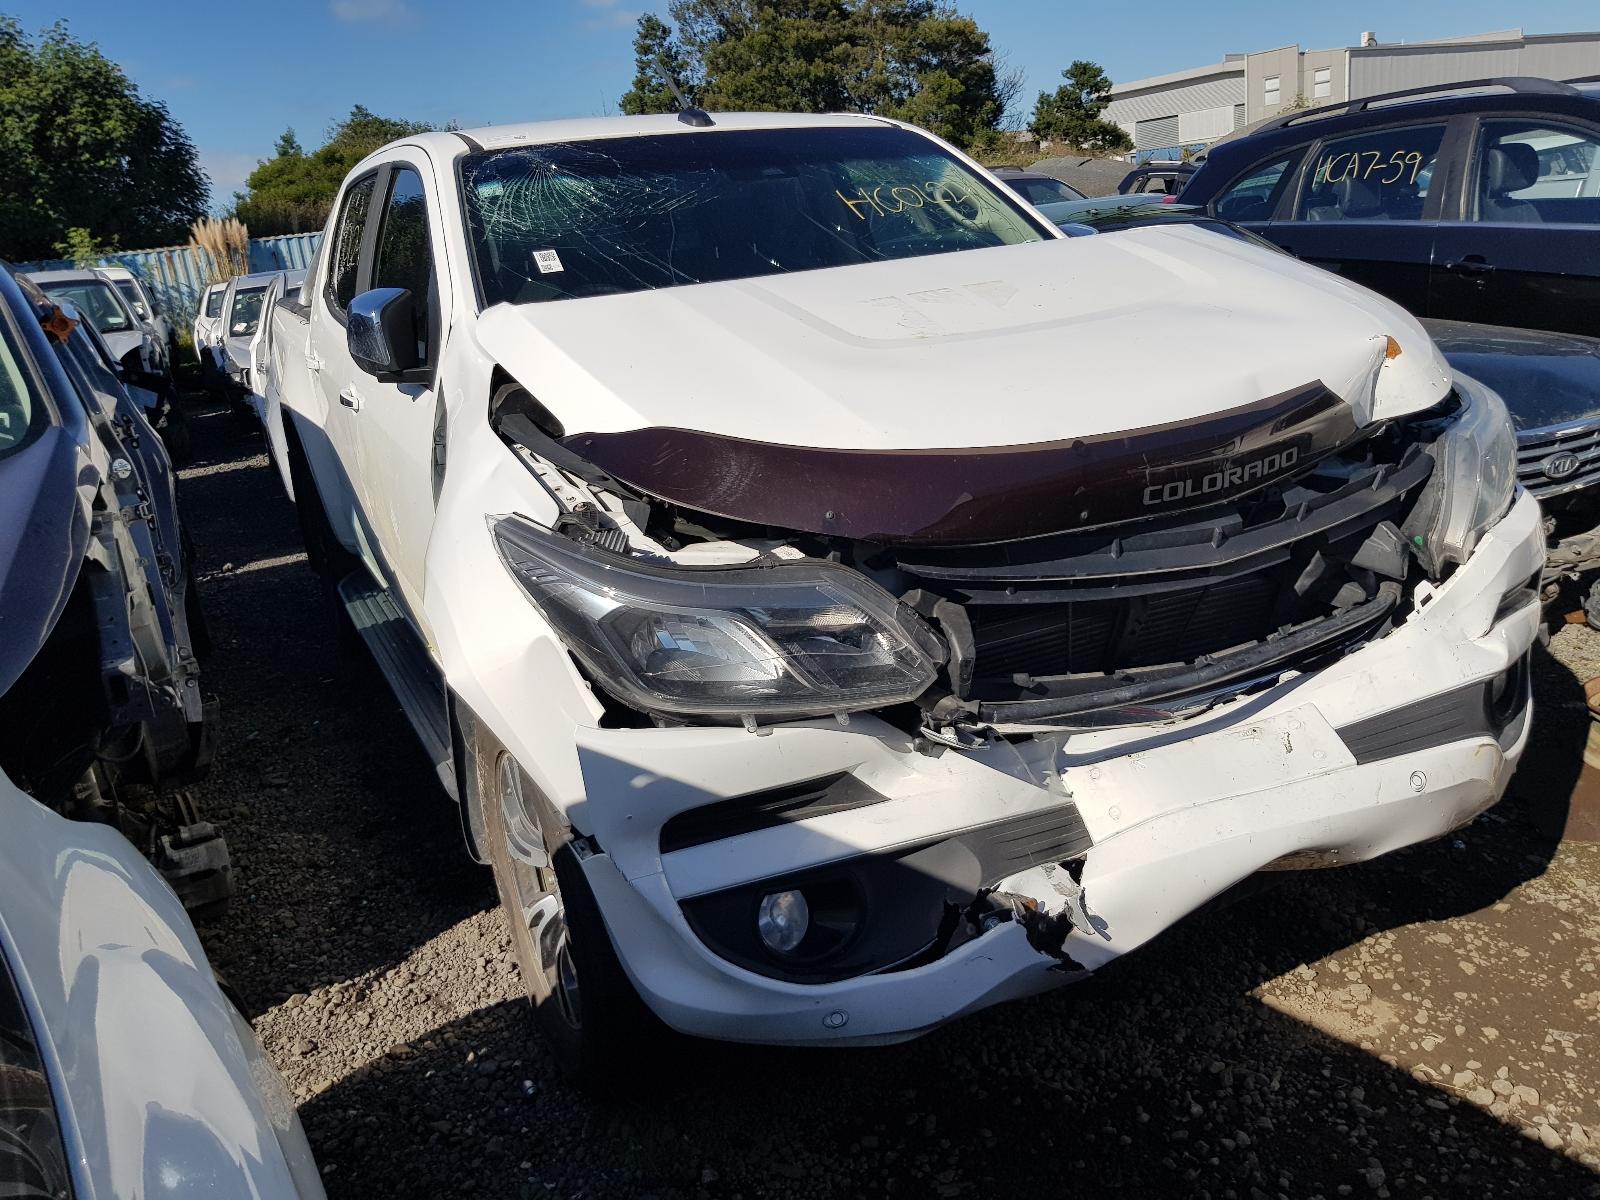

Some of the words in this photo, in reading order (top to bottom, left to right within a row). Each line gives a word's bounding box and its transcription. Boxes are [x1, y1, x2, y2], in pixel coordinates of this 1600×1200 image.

[1311, 150, 1422, 188] HCA7-59
[1142, 446, 1298, 505] COLORADO
[1550, 459, 1574, 475] KIA
